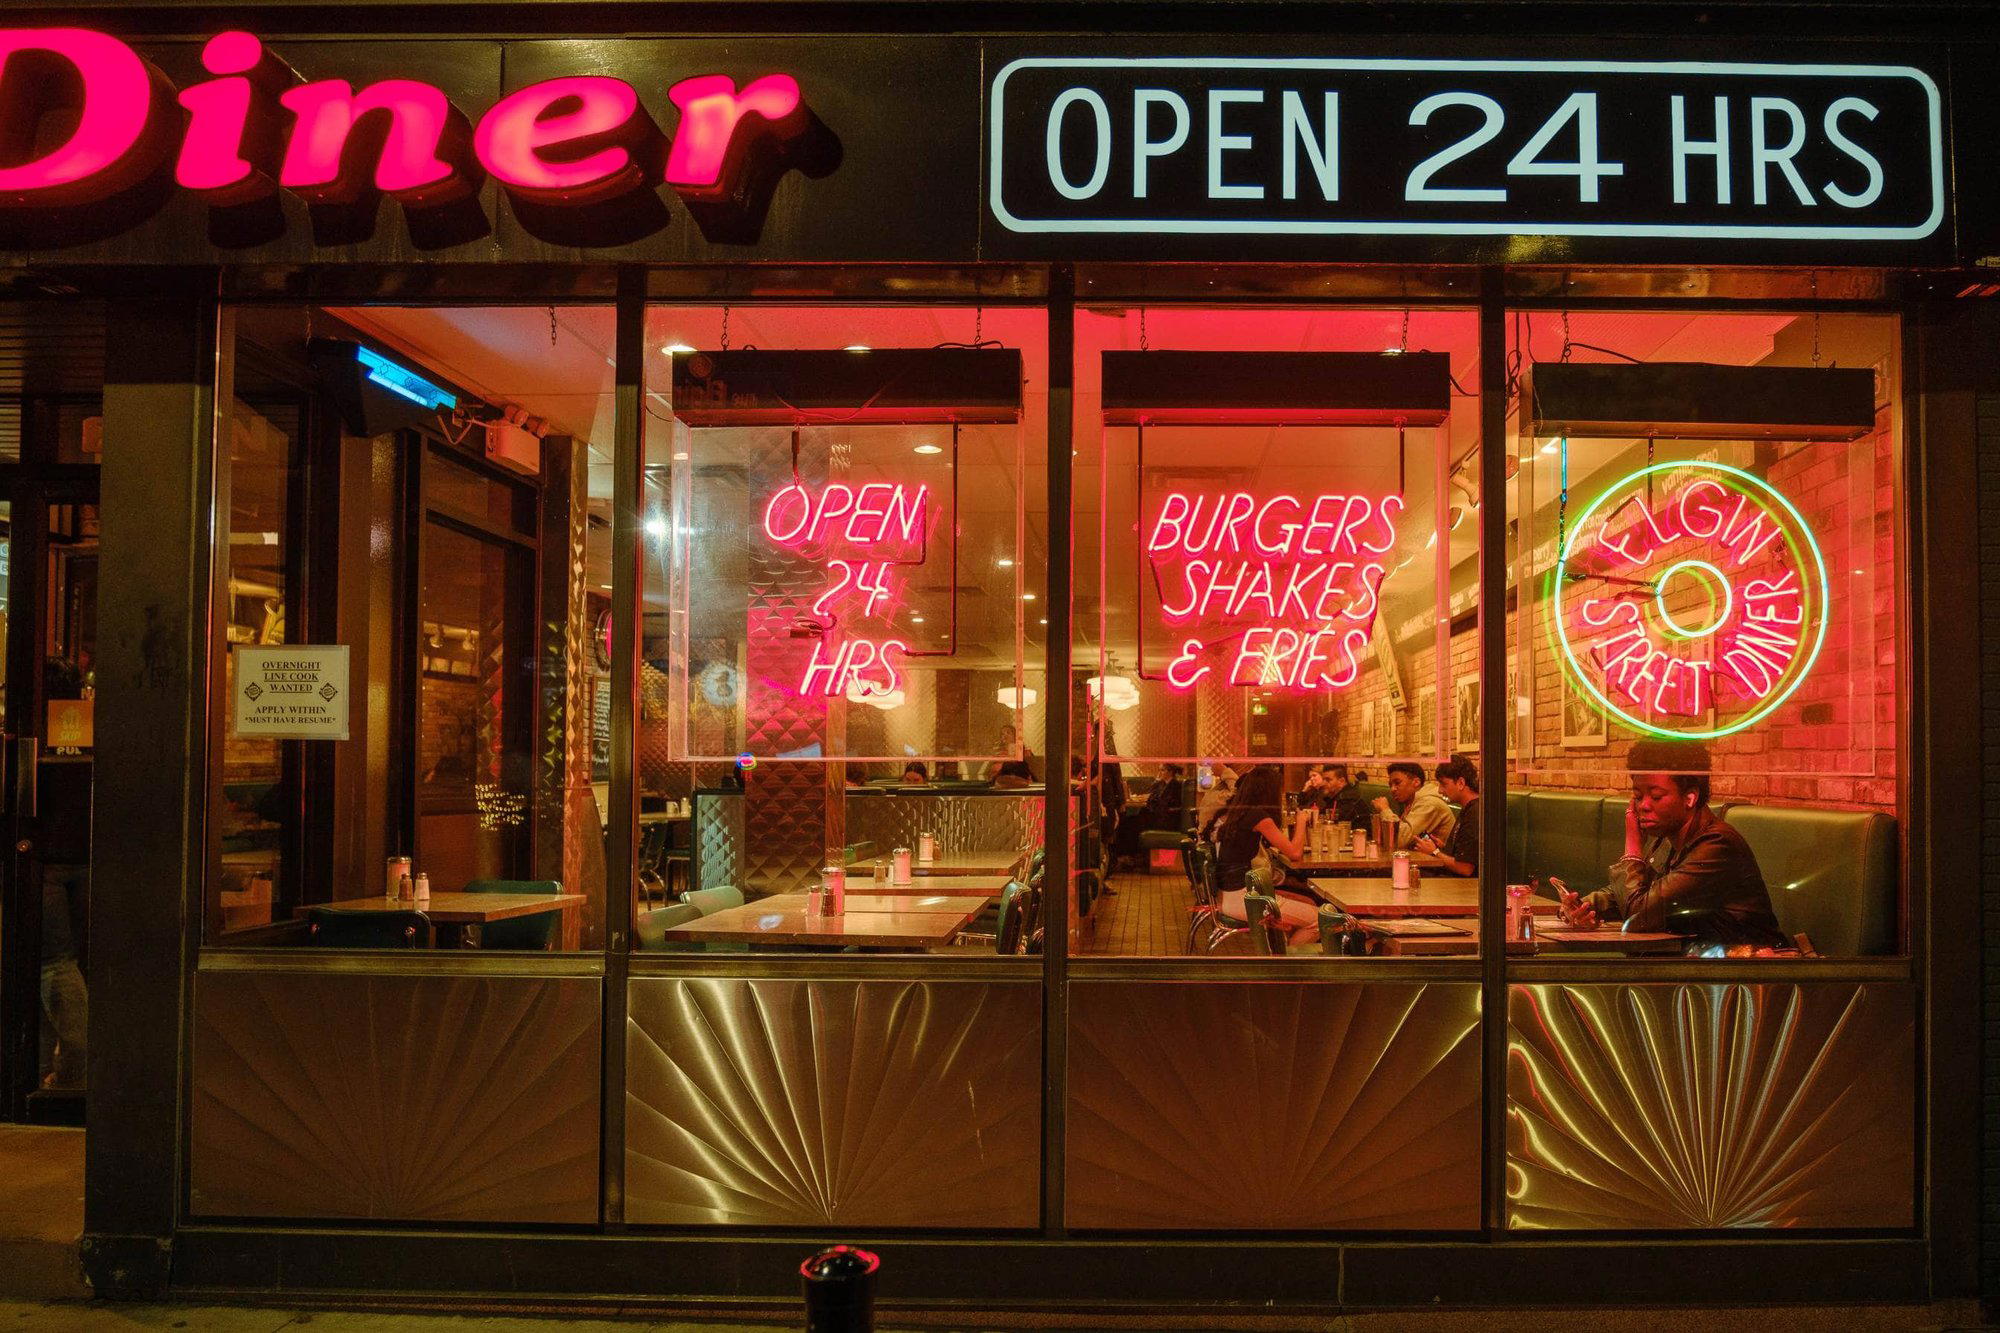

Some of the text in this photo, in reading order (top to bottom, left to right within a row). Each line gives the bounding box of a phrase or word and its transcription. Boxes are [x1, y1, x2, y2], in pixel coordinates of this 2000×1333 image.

[0, 28, 800, 191] Diner
[1046, 87, 1885, 208] OPEN 24 HRS
[764, 482, 927, 544] OPEN
[1148, 492, 1405, 555] BURGERS
[1598, 480, 1783, 567] ELGIN
[813, 559, 892, 618] 24
[1161, 558, 1387, 620] SHAKES
[1167, 626, 1369, 689] & FRIES
[1581, 597, 1711, 717] STREET
[1723, 570, 1803, 698] DINER
[262, 661, 321, 670] OVERNIGHT
[264, 672, 319, 681] LINE COOK
[269, 684, 313, 693] WANTED
[799, 638, 908, 698] HRS
[255, 705, 326, 714] APPLY WITHIN
